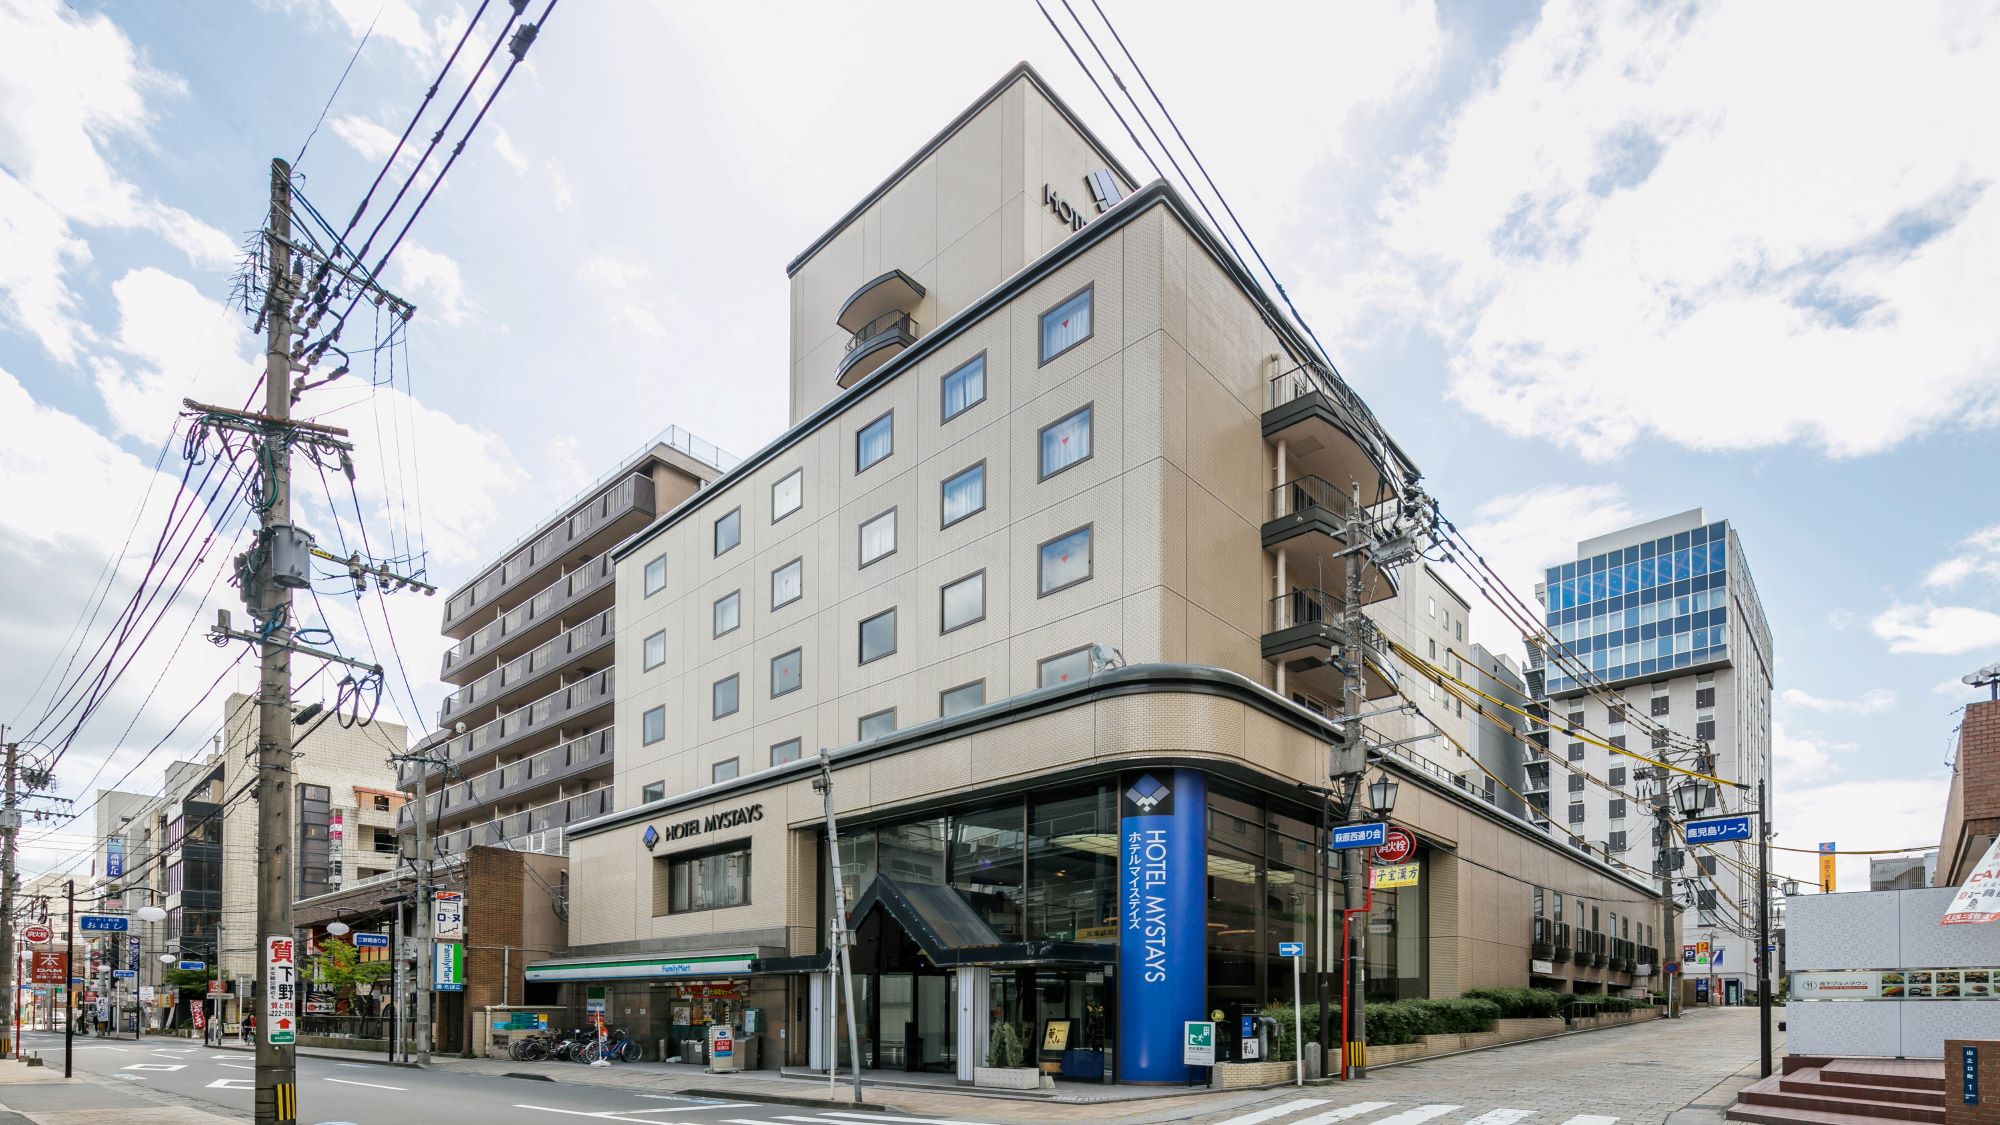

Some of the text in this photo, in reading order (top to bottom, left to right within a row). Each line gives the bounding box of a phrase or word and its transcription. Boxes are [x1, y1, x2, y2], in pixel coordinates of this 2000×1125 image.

[666, 804, 763, 841] HOTEL MYSTAYS
[1688, 823, 1747, 838] 鹿児島リース
[1128, 832, 1141, 929] ホテルマイステイズ
[1377, 867, 1417, 882] 子宝漢方
[1145, 830, 1166, 983] HOTEL MYSTAYS
[271, 940, 292, 963] 質
[443, 944, 452, 982] FamilyMart
[662, 964, 690, 973] FamilyMart
[278, 966, 294, 1000] 下野
